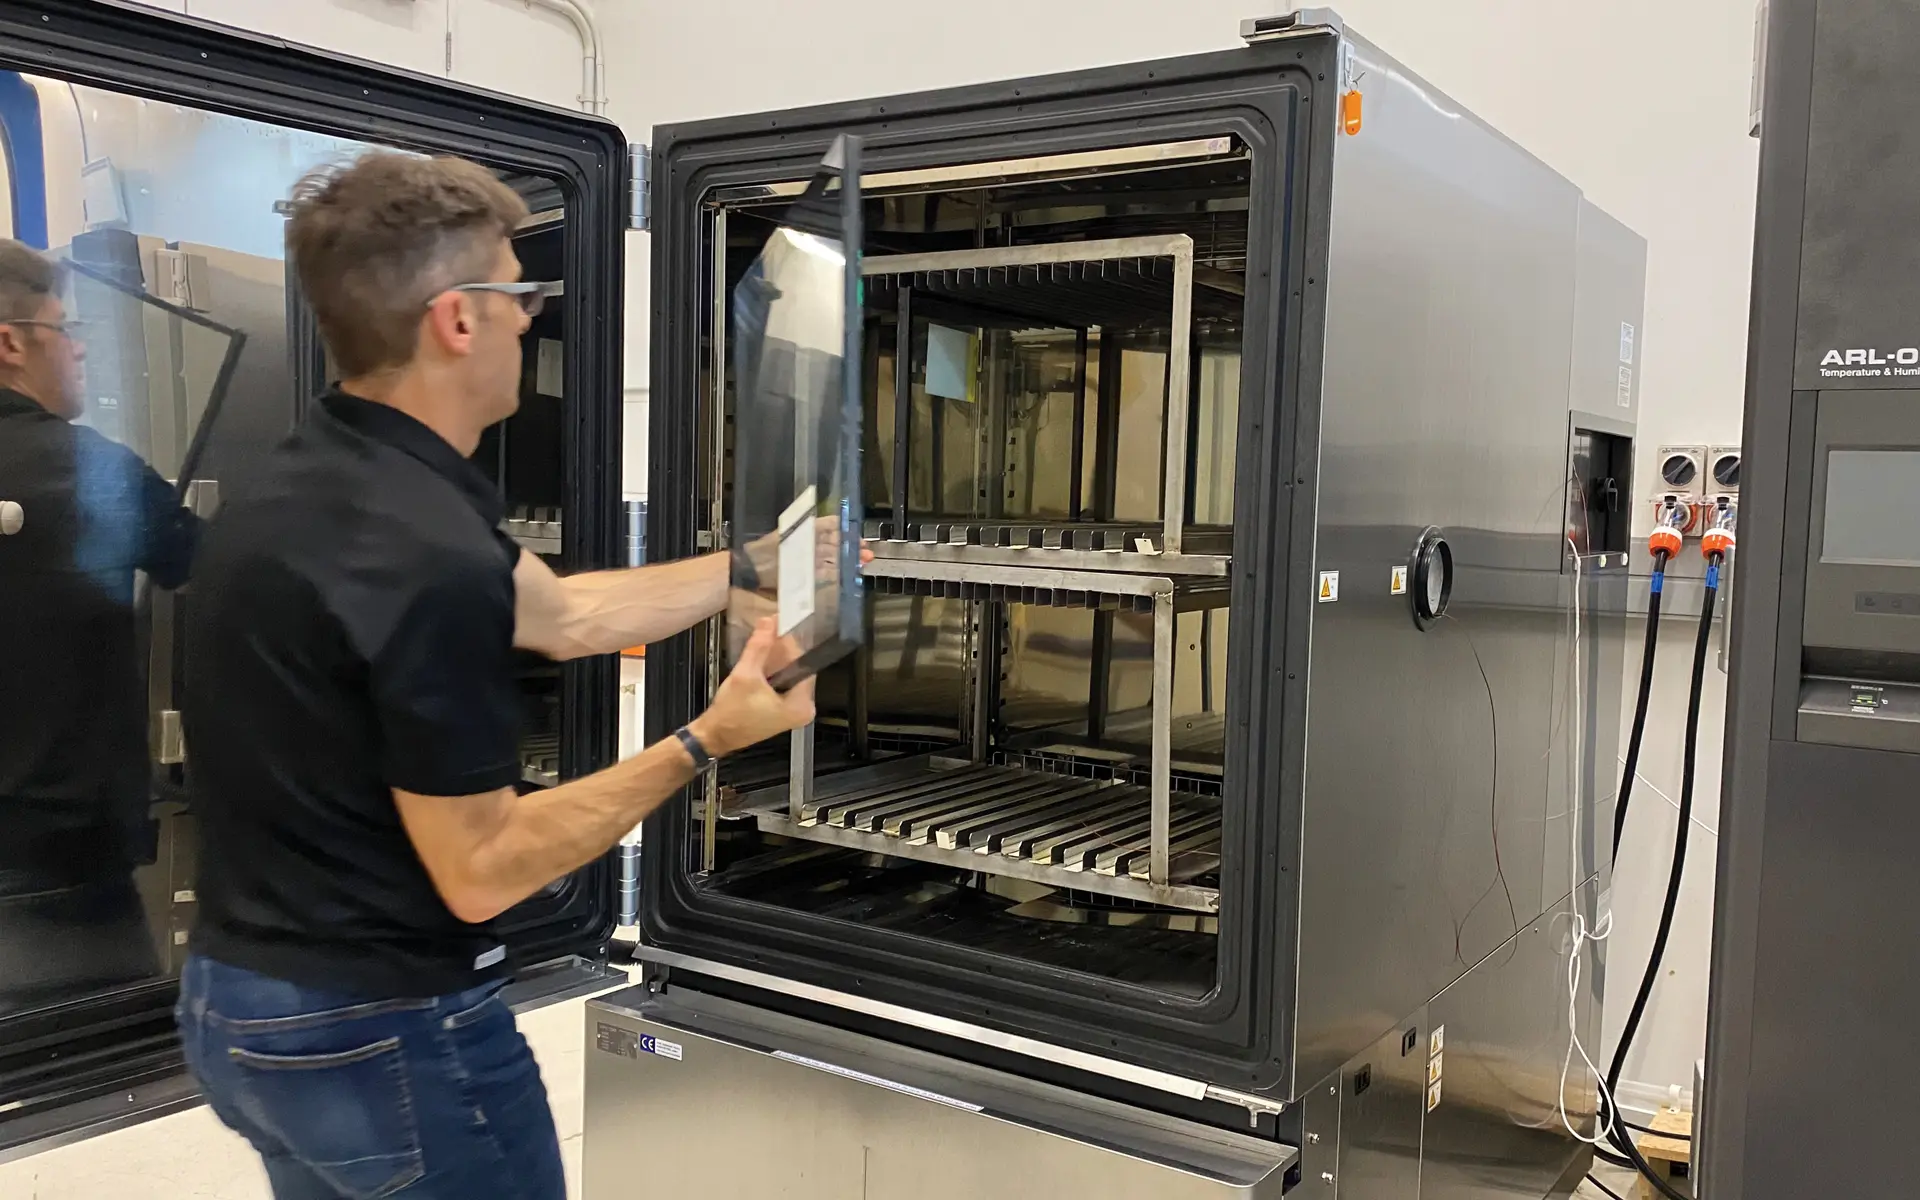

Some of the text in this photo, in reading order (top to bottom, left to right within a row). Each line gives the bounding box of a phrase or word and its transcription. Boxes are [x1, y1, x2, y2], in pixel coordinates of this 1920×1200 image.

[1820, 368, 1881, 378] Temperature
[1883, 367, 1892, 376] &
[641, 1036, 654, 1051] CE
